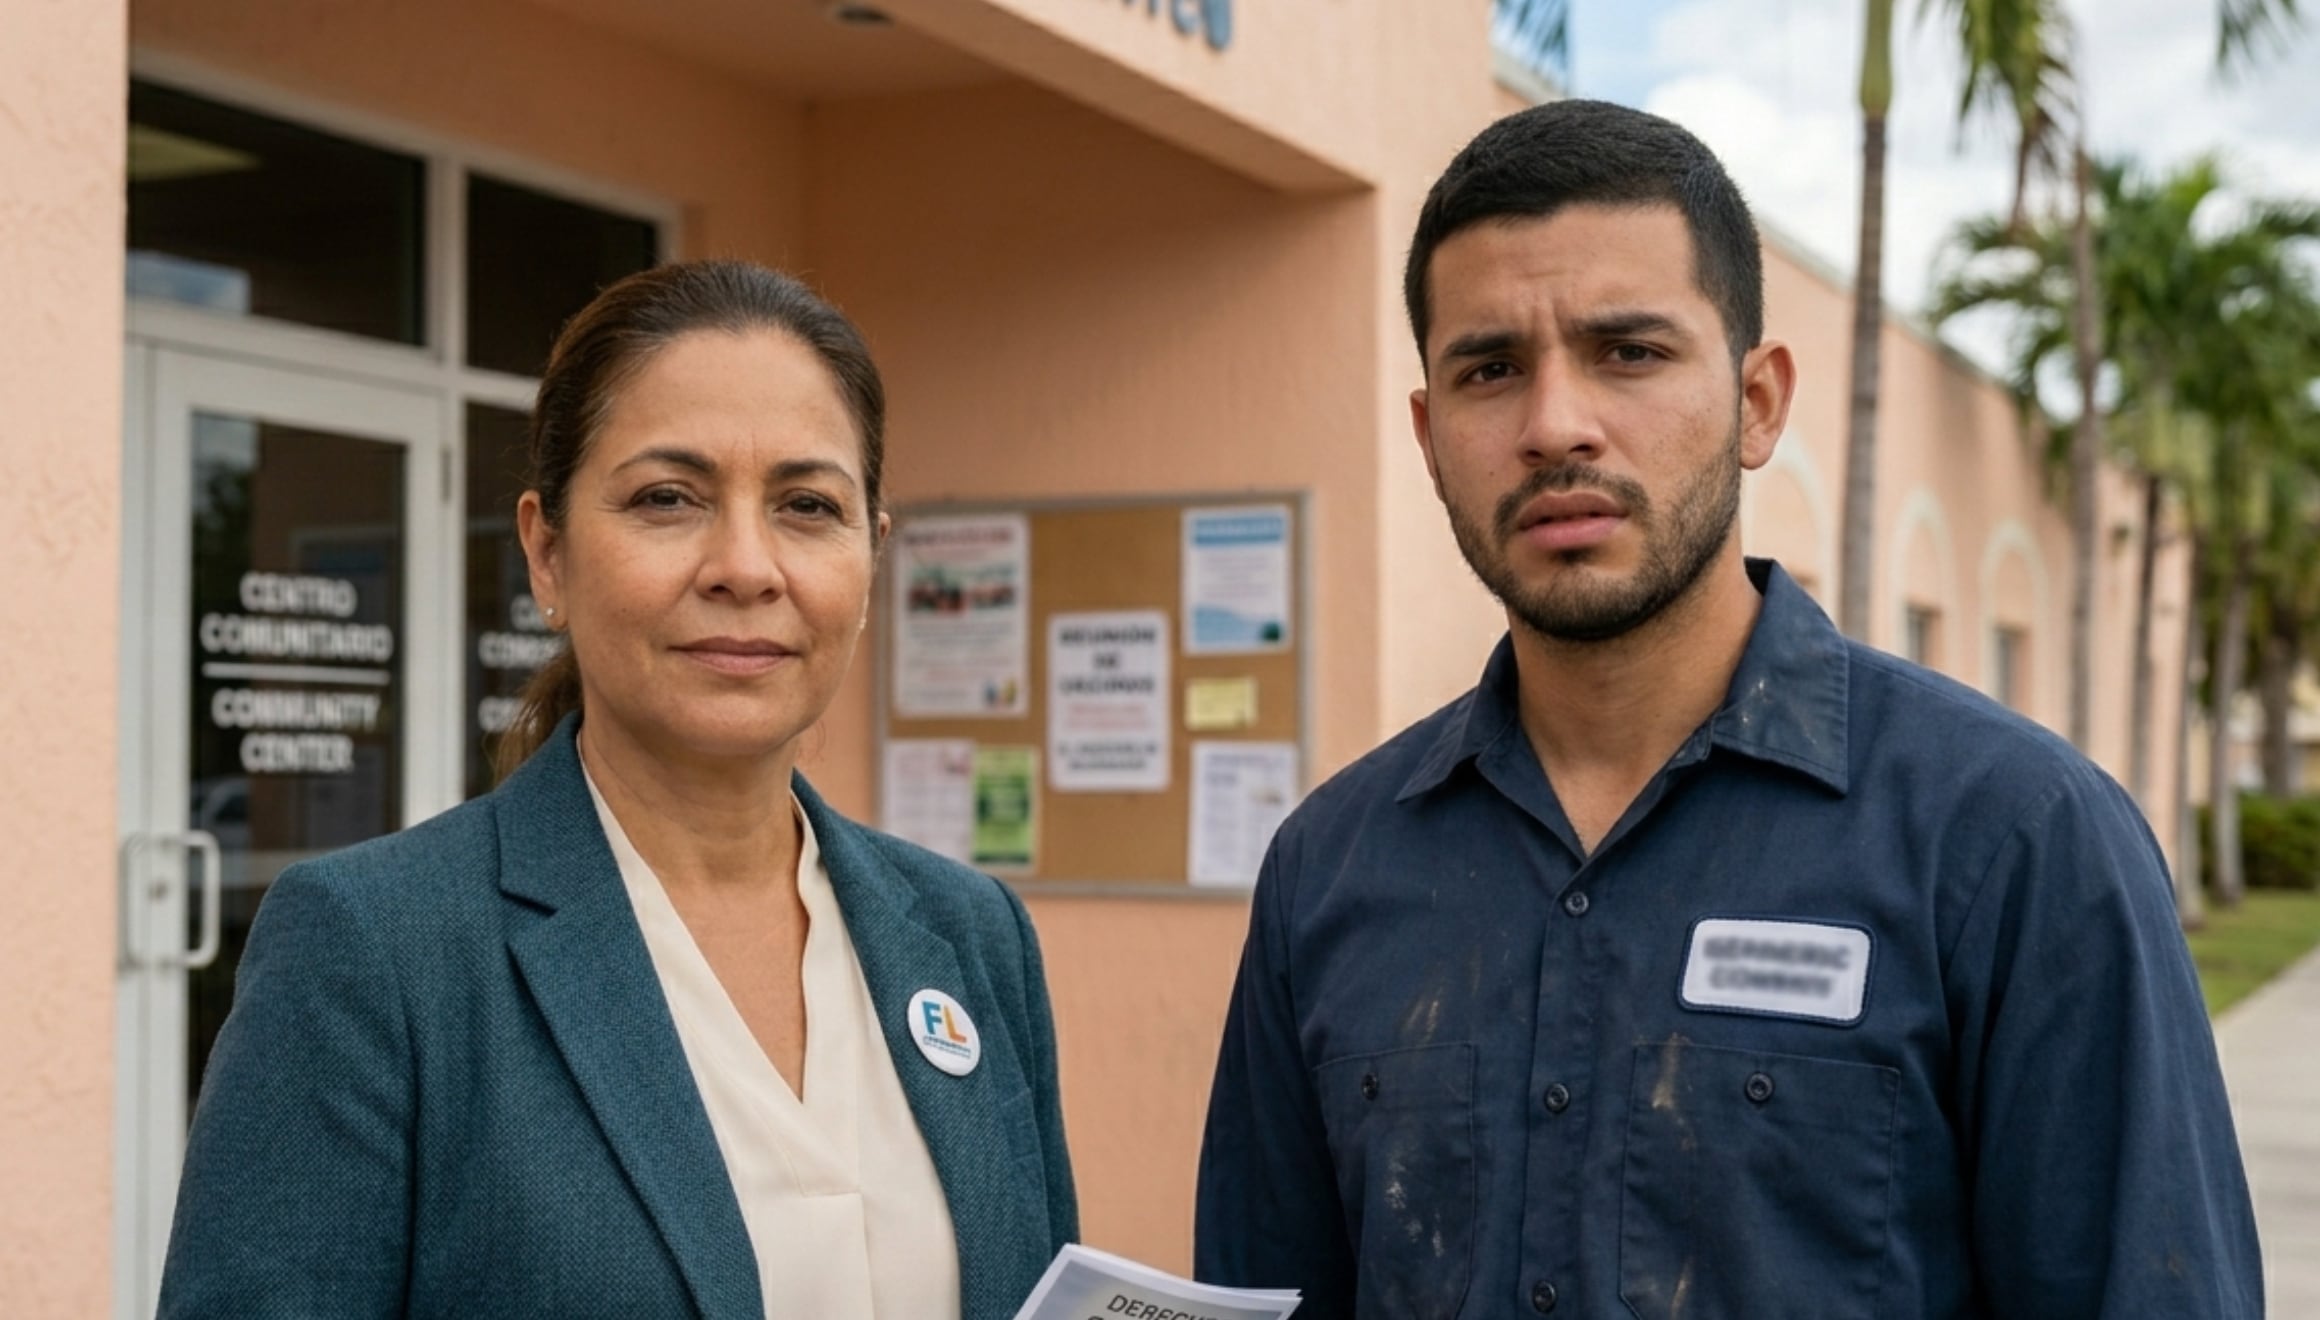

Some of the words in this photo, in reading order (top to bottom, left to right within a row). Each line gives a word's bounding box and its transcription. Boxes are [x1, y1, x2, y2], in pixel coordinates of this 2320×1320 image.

[240, 572, 357, 617] CENTRO
[201, 613, 393, 661] COMUNITARIO
[212, 688, 380, 730] COMMUNITY
[240, 732, 353, 771] CENTER
[922, 1001, 967, 1043] FL
[1107, 1294, 1219, 1320] DERE
